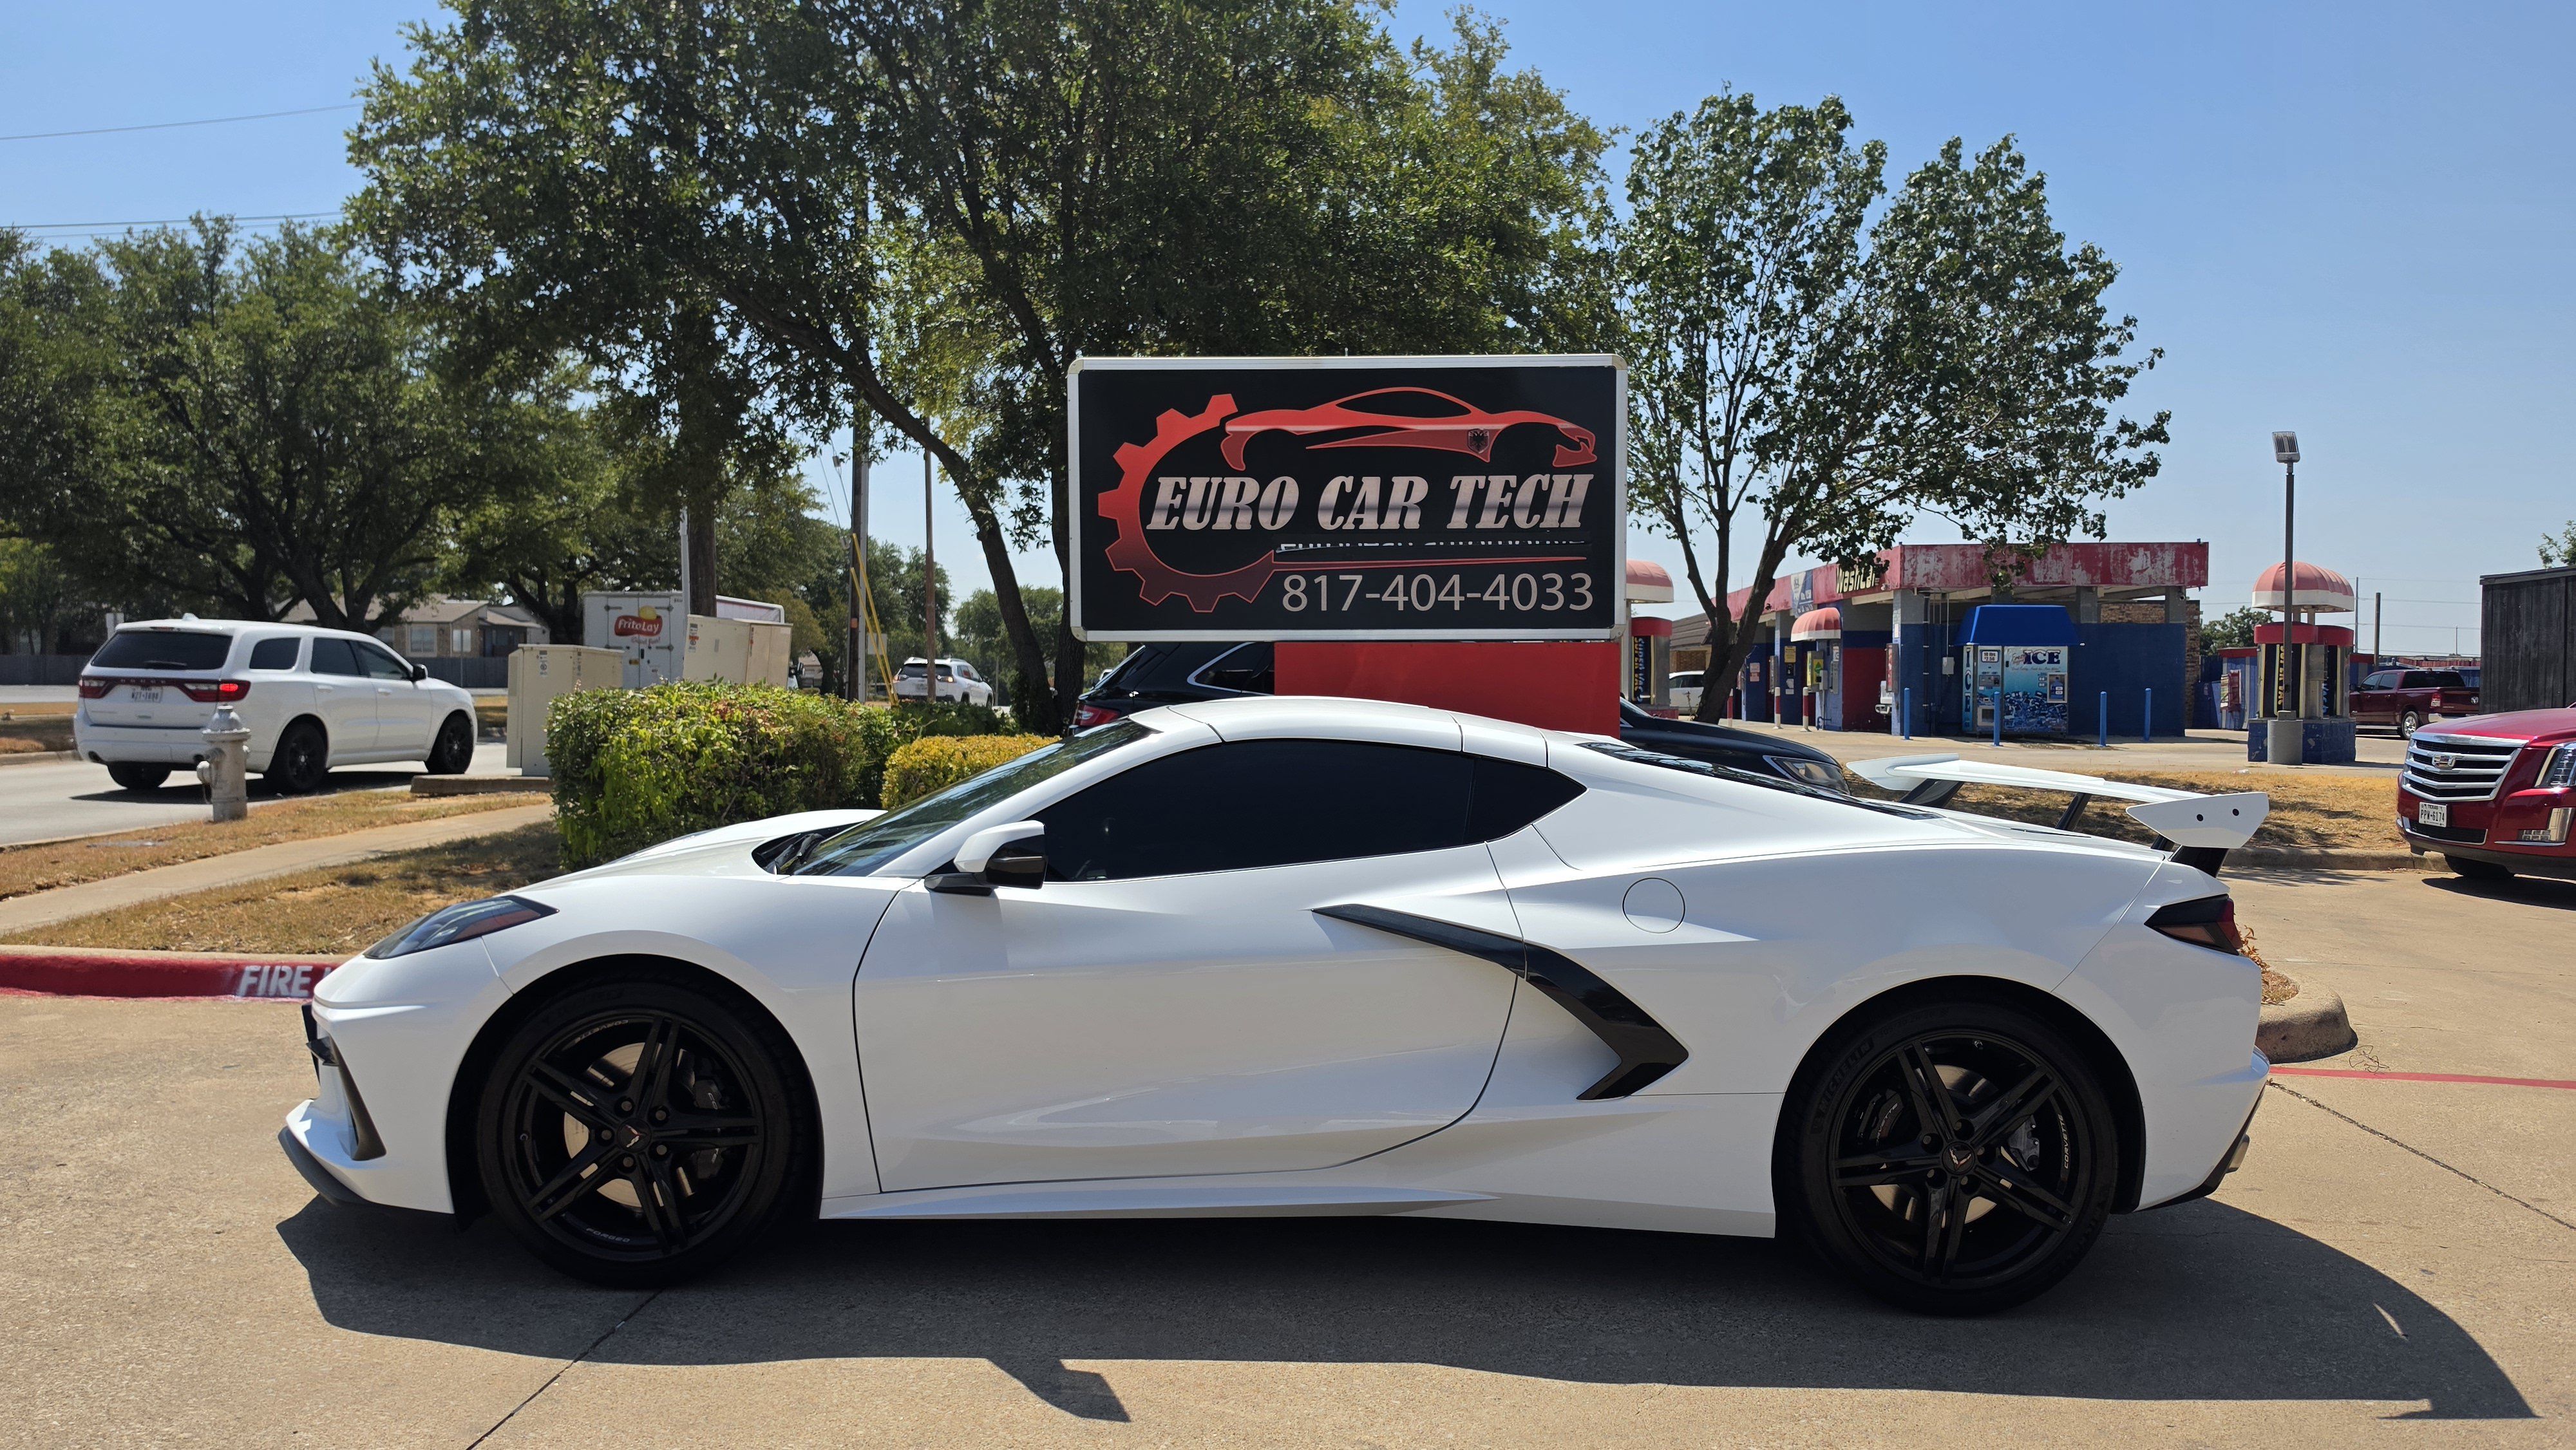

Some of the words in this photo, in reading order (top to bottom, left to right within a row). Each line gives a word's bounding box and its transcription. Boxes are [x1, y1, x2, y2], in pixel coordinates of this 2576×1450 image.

[1146, 476, 1300, 531] EURO
[1318, 475, 1428, 531] CAR
[1446, 473, 1595, 530] TECH
[1282, 572, 1594, 612] 817-404-4033
[2023, 649, 2061, 664] ICE
[236, 966, 313, 997] FIRE
[1817, 1040, 1873, 1115] MICHELIN
[1875, 1102, 1898, 1147] RVETTE
[2058, 1113, 2069, 1169] CORVETTE
[586, 1227, 630, 1243] FORGED
